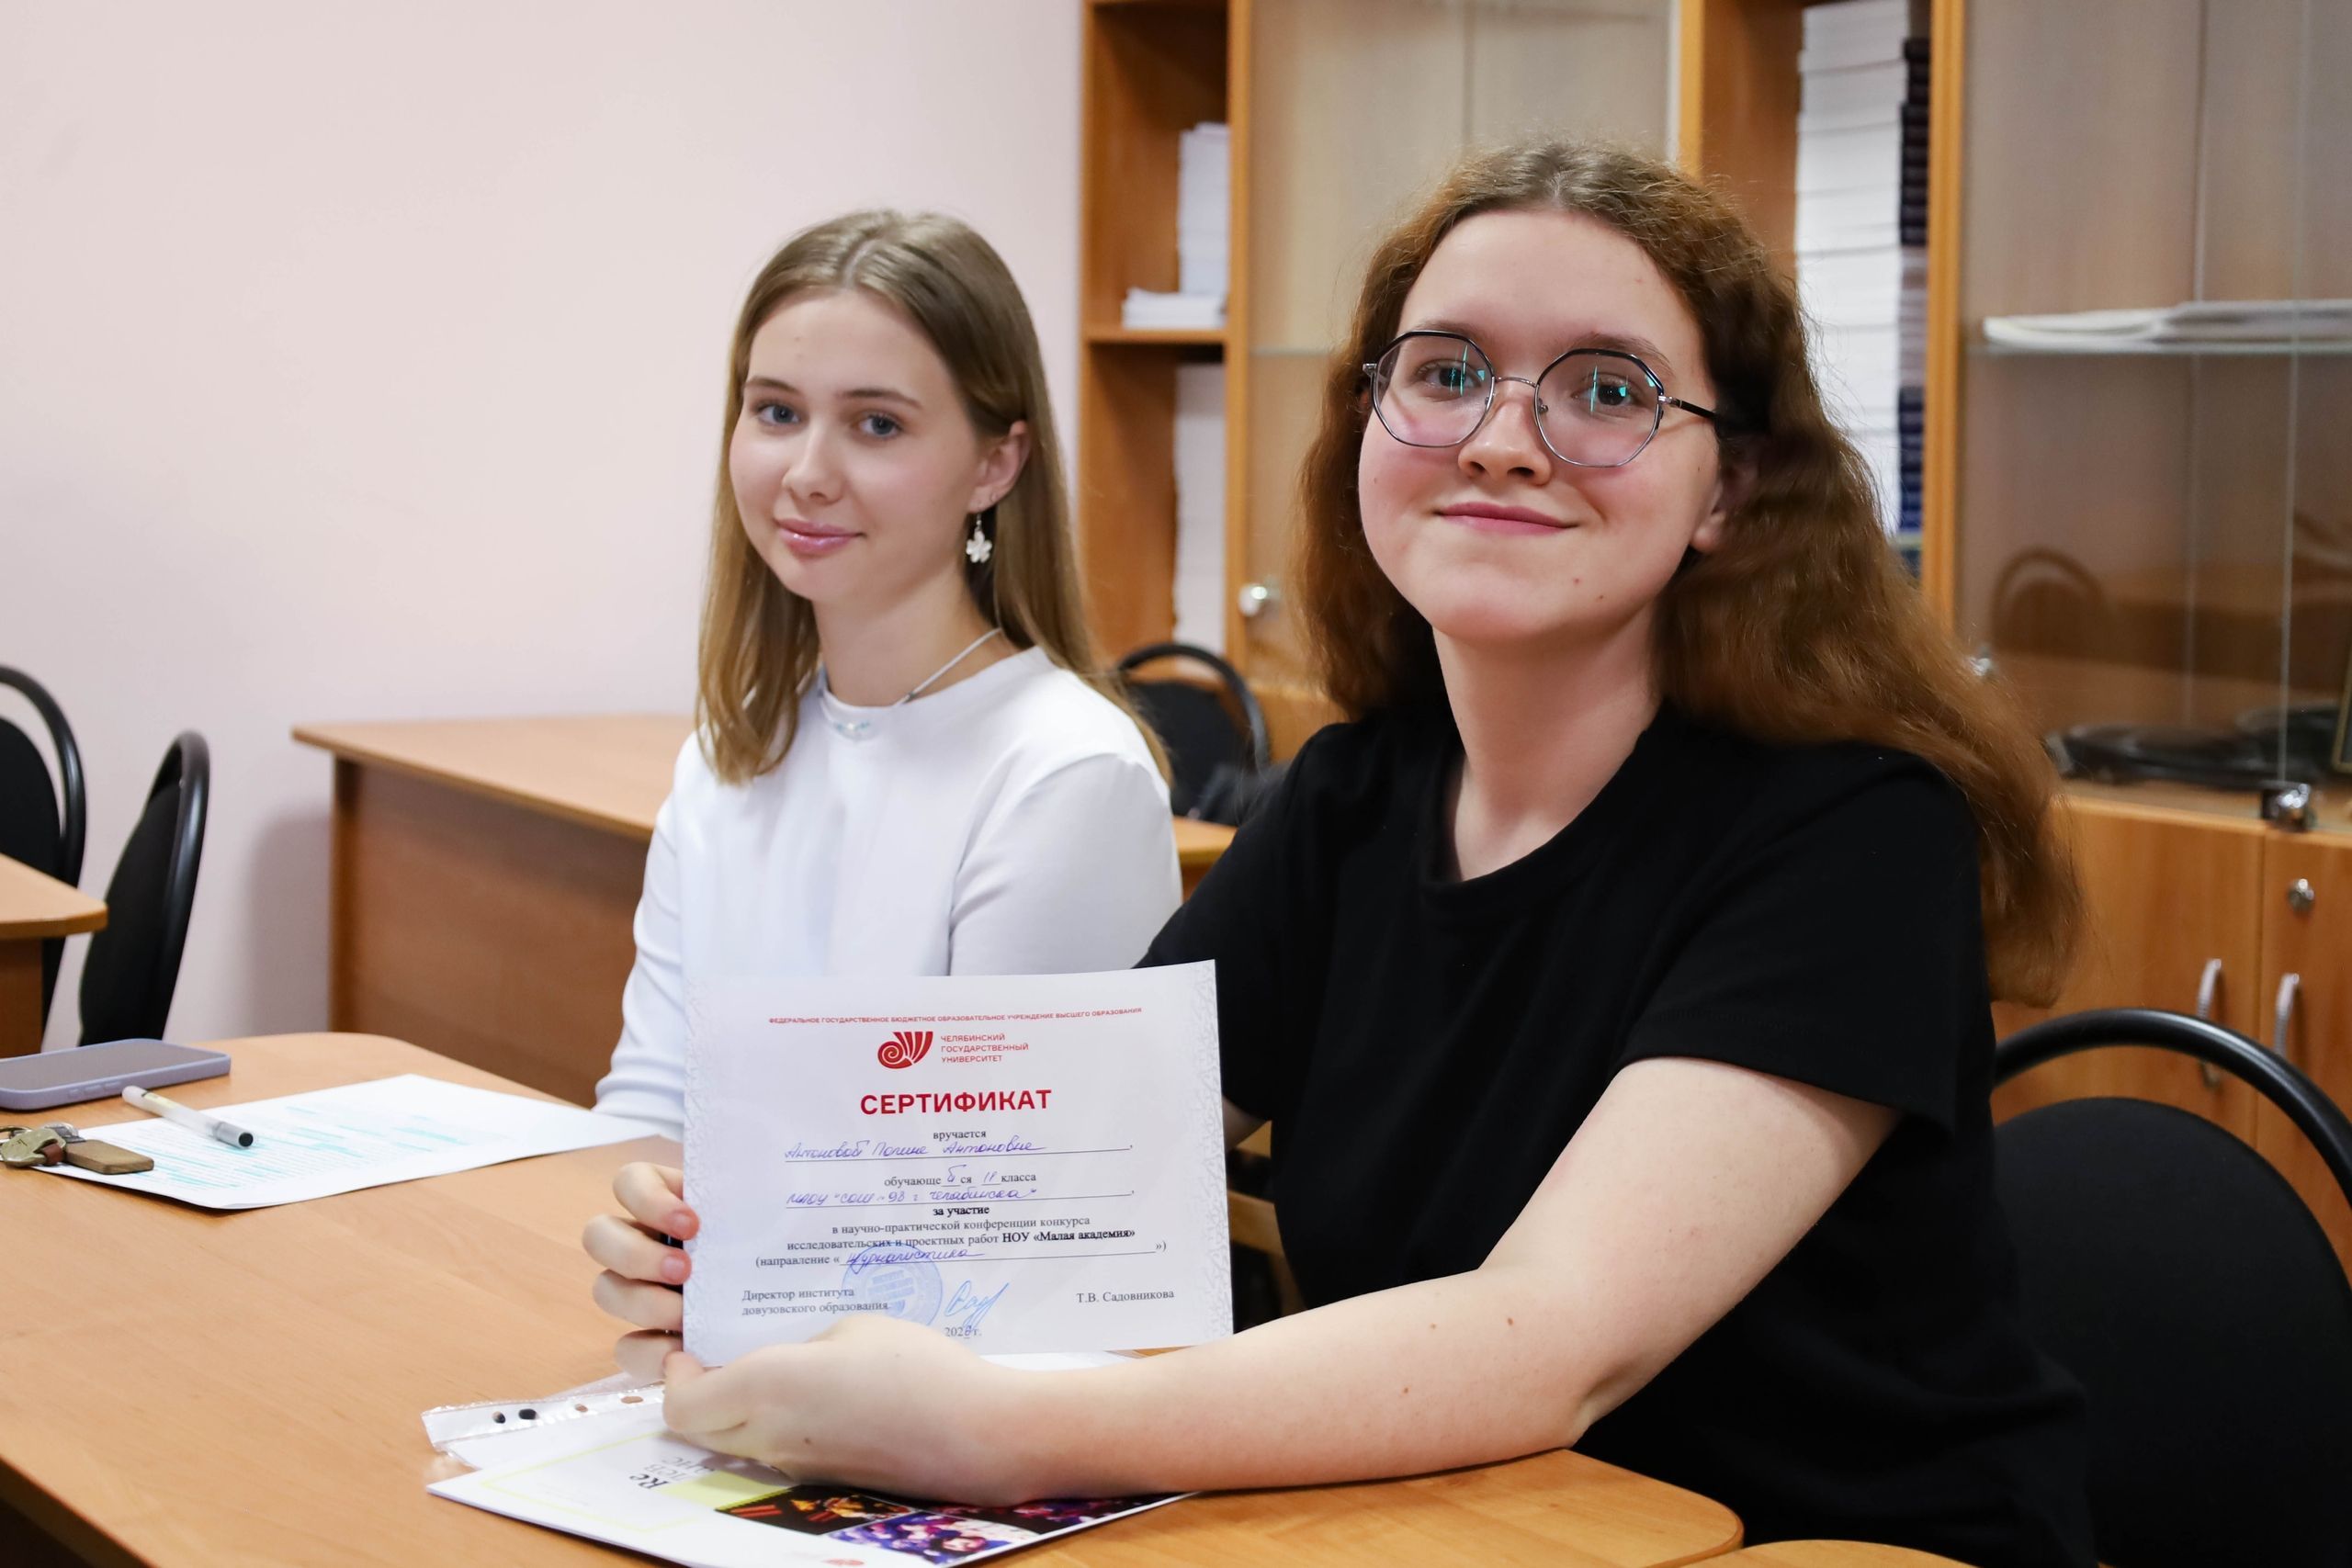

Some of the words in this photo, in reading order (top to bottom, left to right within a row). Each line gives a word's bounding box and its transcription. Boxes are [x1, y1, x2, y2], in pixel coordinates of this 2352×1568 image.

[821, 1016, 889, 1024] ГОСУДАРСТВЕННОЕ
[938, 1014, 1005, 1022] ОБРАЗОВАТЕЛЬНОЕ
[1007, 1012, 1055, 1021] УЧРЕЖДЕНИЕ
[1091, 1007, 1143, 1017] ОБРАЗОВАНИЯ
[940, 1032, 1005, 1043] ЧЕЛЯБИНСКИЙ
[941, 1043, 1029, 1053] ГОСУДАРСТВЕННЫЙ
[941, 1055, 1003, 1064] УНИВЕРСИТЕТ
[860, 1089, 1052, 1115] СЕРТИФИКАТ
[933, 1130, 987, 1142] вручается
[884, 1175, 942, 1189] обучающе
[960, 1176, 973, 1184] ся
[1001, 1173, 1036, 1183] класса
[933, 1207, 944, 1216] за
[947, 1206, 989, 1217] участие
[832, 1226, 839, 1235] в
[841, 1221, 961, 1236] научно-практической
[963, 1219, 1037, 1232] конференции
[1040, 1217, 1091, 1230] конкурса
[786, 1237, 892, 1251] исследовательских
[905, 1235, 965, 1248] проектных
[967, 1234, 999, 1247] работ
[1001, 1232, 1030, 1243] НОУ
[1033, 1230, 1076, 1242] «Малая
[1078, 1228, 1136, 1240] академия»
[755, 1255, 831, 1269] (направление
[741, 1289, 796, 1303] Директор
[798, 1288, 855, 1300] института
[1102, 1290, 1175, 1303] Садовникова
[741, 1304, 817, 1316] довузовского
[820, 1302, 888, 1316] образования
